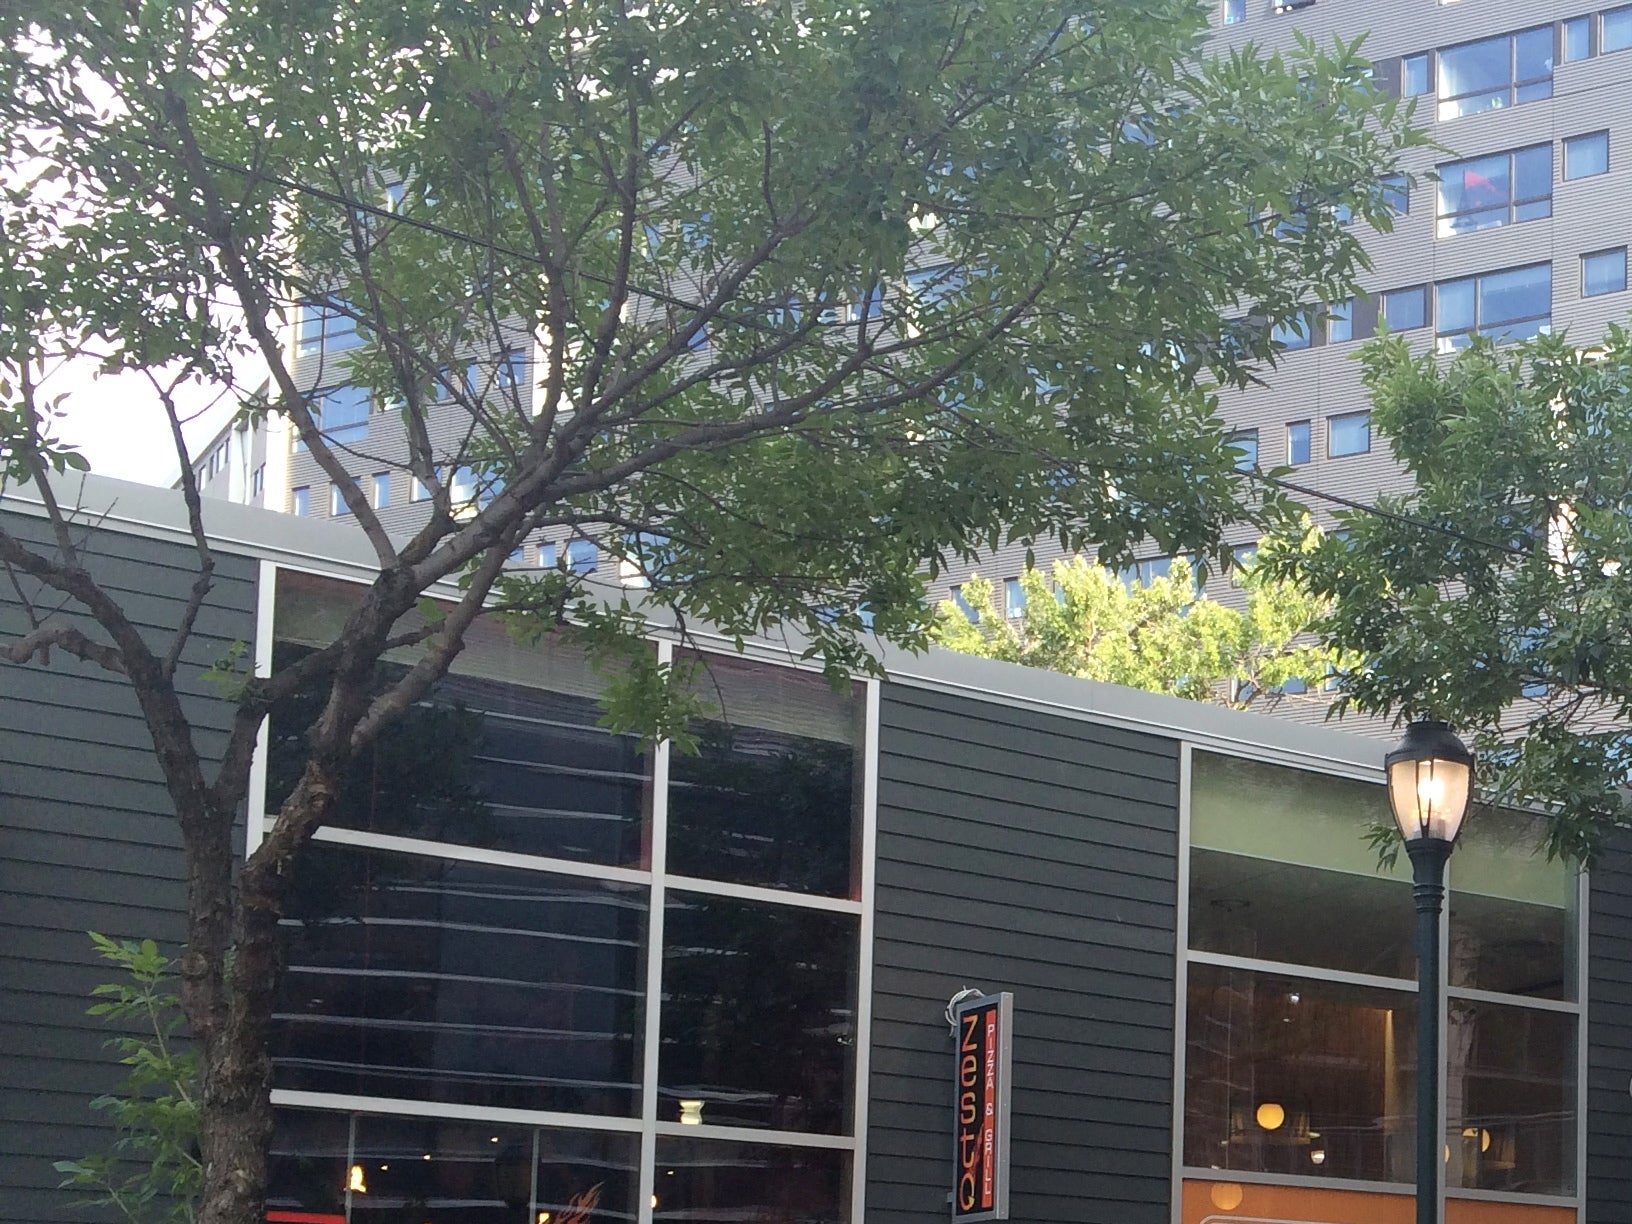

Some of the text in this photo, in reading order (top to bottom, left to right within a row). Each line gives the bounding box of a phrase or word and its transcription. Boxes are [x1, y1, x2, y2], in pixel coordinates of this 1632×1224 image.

[960, 1014, 978, 1211] Zesto
[984, 1024, 995, 1195] PIZZA & GRILL
